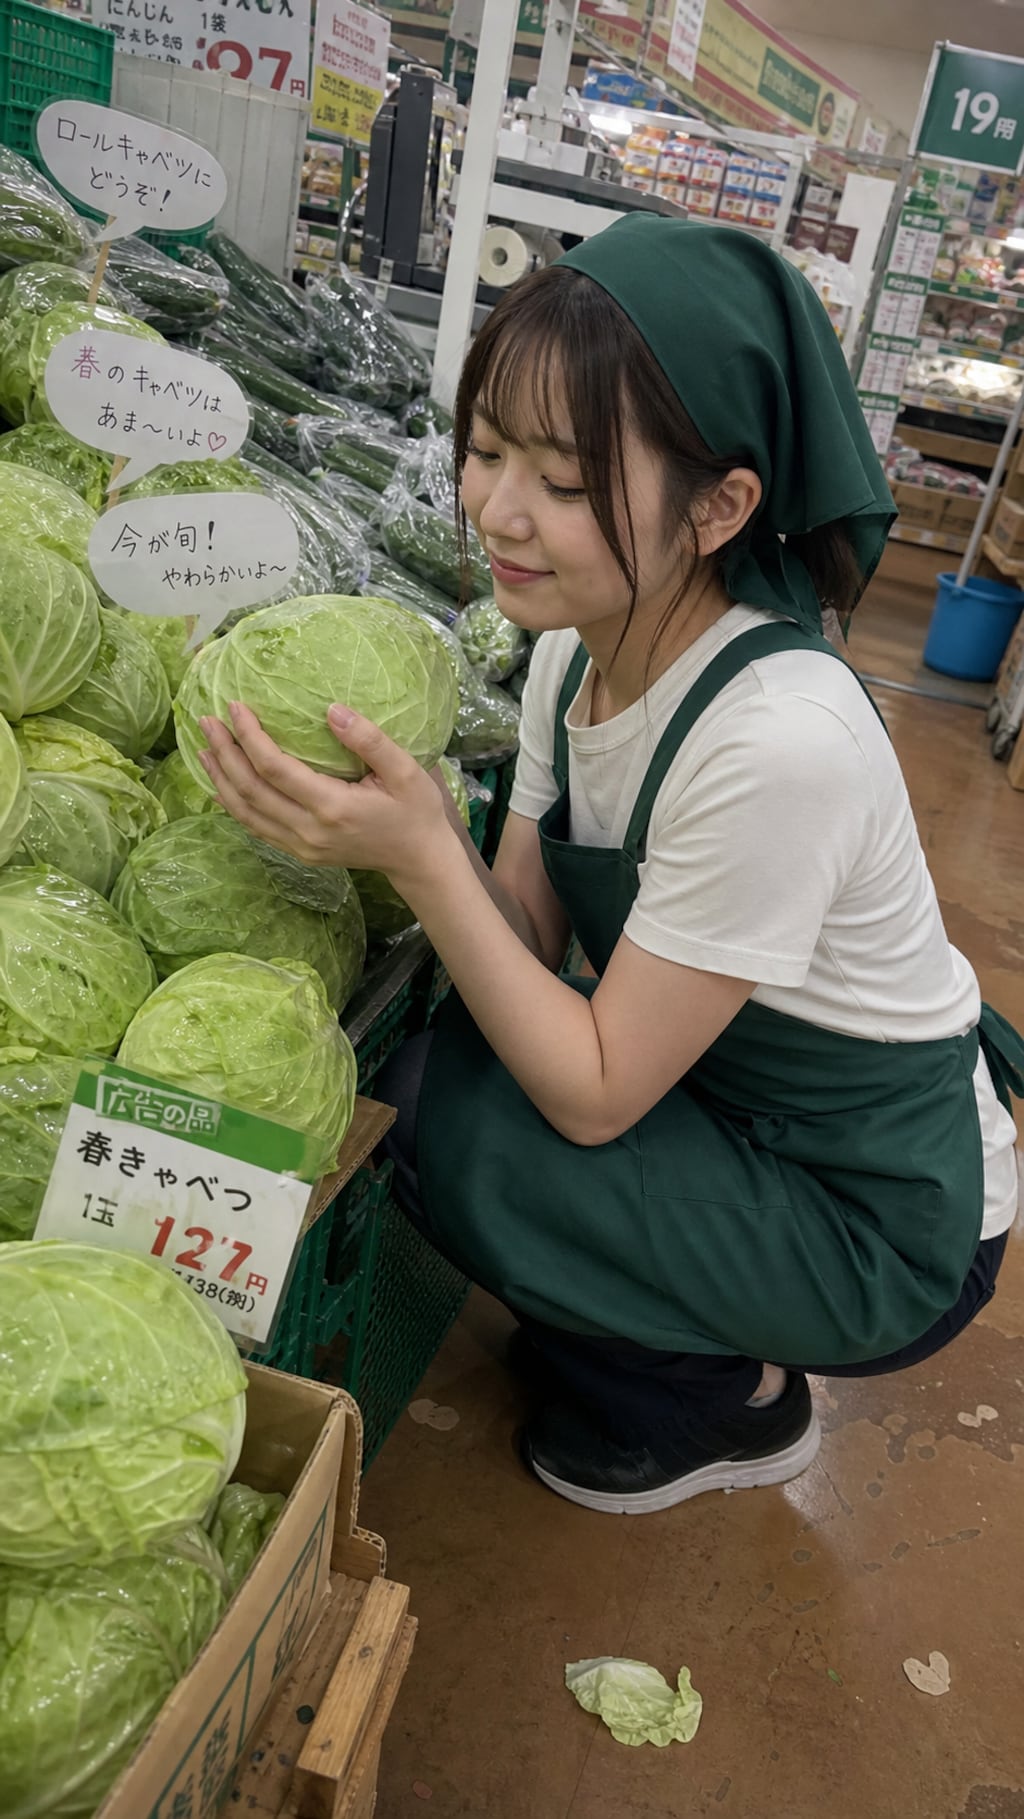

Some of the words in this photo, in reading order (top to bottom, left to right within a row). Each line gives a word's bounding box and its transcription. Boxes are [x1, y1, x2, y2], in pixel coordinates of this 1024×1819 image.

[107, 0, 174, 24] にんじん
[201, 12, 227, 34] 1袋
[57, 117, 212, 188] ロールキャベツに
[89, 165, 173, 213] どうぞ！
[71, 345, 222, 413] 春のキャベツは
[111, 520, 216, 558] 今が旬！
[76, 1130, 253, 1212] 春きゃべつ
[81, 1193, 119, 1228] 1玉
